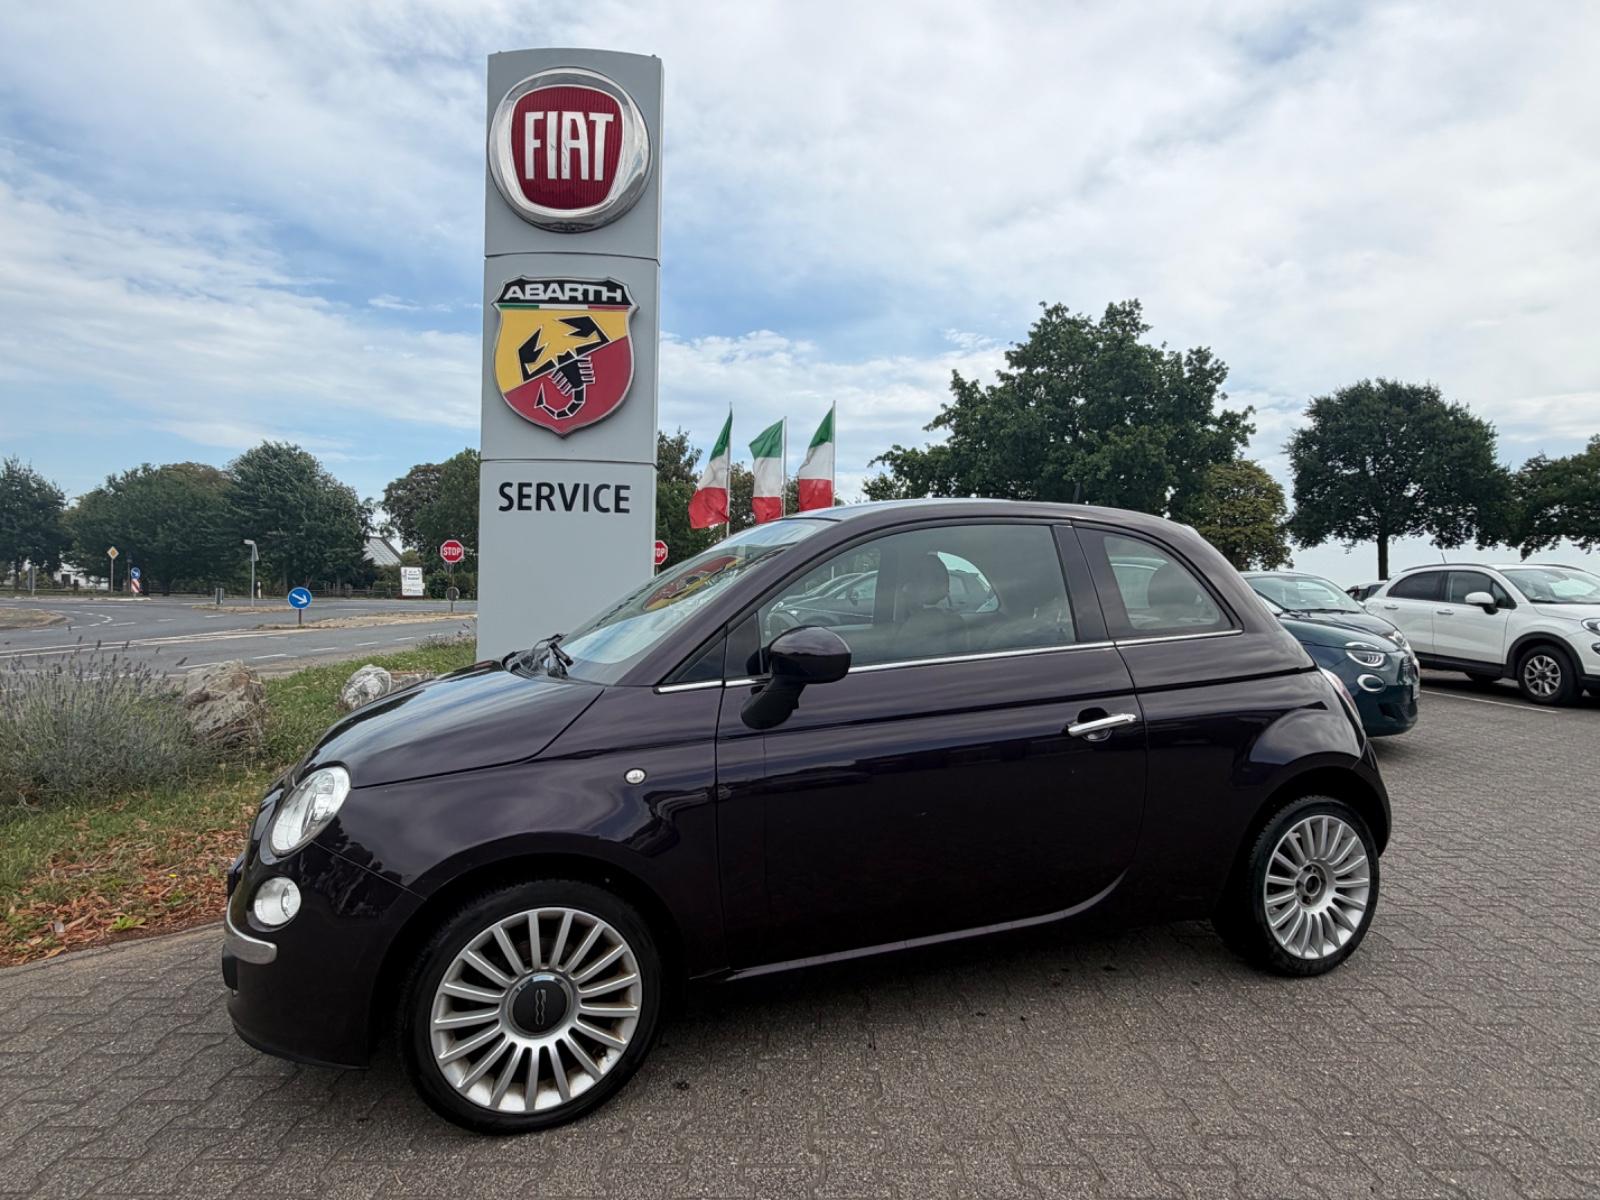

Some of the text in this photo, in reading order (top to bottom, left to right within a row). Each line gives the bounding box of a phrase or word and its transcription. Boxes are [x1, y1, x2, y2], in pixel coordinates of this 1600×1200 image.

[525, 111, 614, 181] FIAT
[503, 283, 622, 302] ABARTH
[498, 482, 631, 513] SERVICE
[443, 546, 461, 556] STOP
